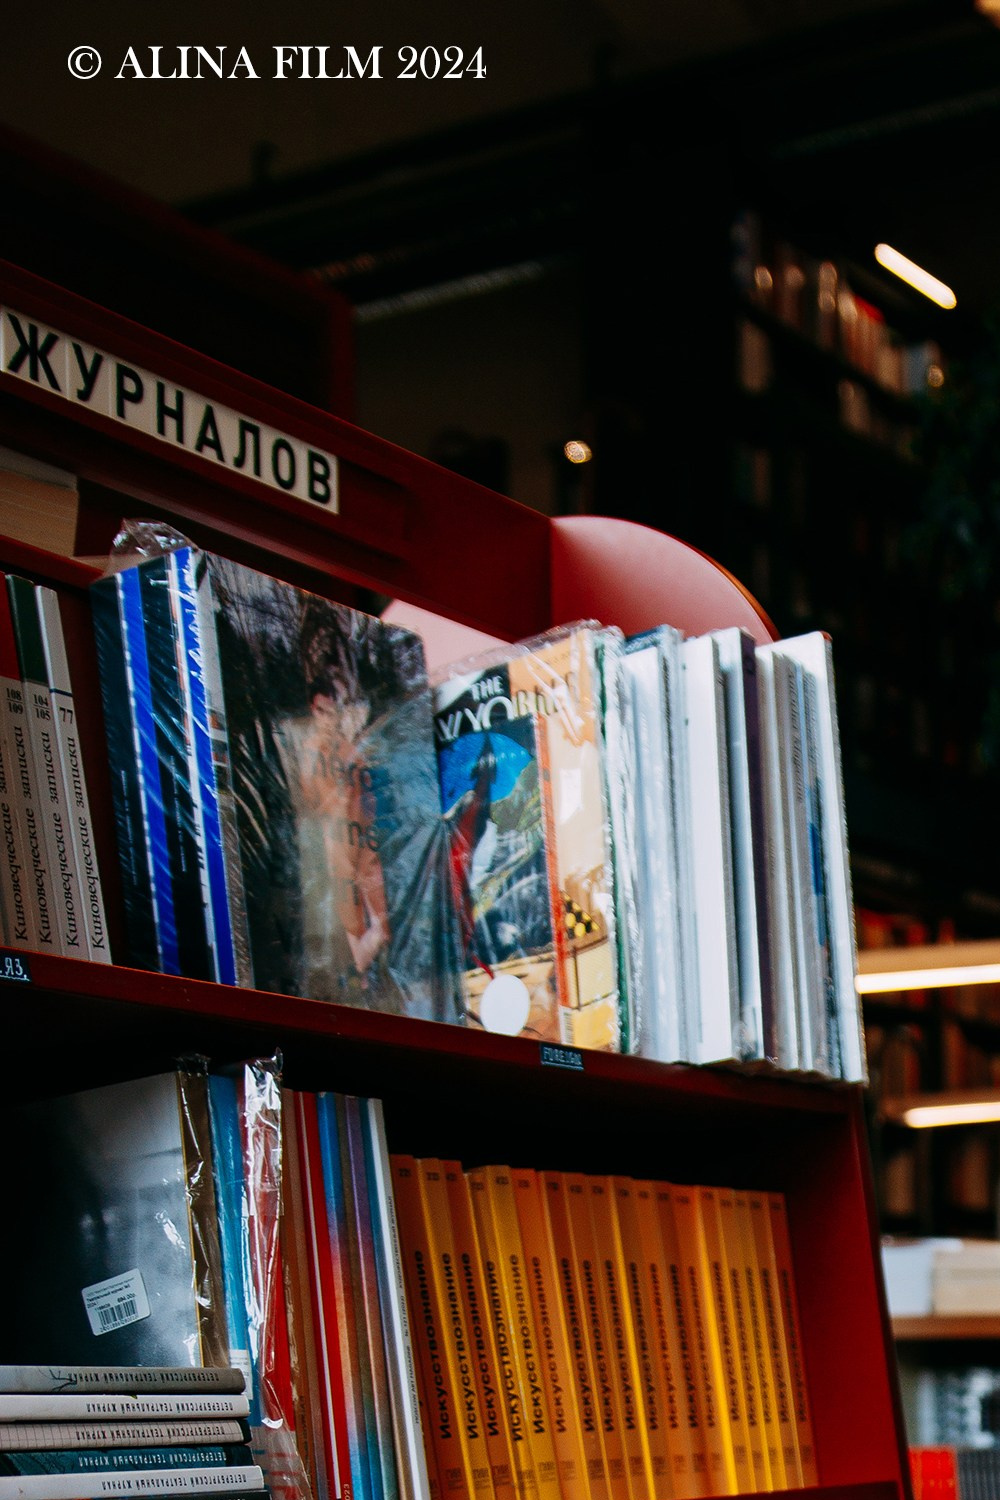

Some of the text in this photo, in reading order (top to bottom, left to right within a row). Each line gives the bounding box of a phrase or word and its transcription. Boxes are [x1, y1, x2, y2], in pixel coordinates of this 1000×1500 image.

[6, 311, 333, 505] ЖУРНАЛОВ
[471, 676, 504, 701] THE
[1, 803, 28, 941] Киноведческие
[14, 726, 52, 944] Киноведческие записки
[41, 731, 80, 947] Киноведческие записки
[60, 707, 105, 949] Киноведческие записки 77
[87, 1402, 234, 1414] ПЕТЕРБУРГСКИЙ ТЕАТРАЛЬНЫЙ ЖУРНАЛ
[104, 1373, 158, 1384] ТЕАТРАЛЬНЫЙ
[160, 1372, 219, 1384] ПЕТЕРБУРГСКИЙ
[415, 1251, 453, 1439] Искусствознание
[442, 1253, 478, 1439] Искусствознание
[461, 1252, 500, 1437] Искусствознание
[487, 1261, 525, 1441] Искусствознание
[510, 1254, 546, 1434] Искусствознание
[532, 1256, 567, 1433] Искусствознание
[561, 1258, 596, 1432] Искусствознание
[583, 1260, 615, 1432] Искусствознание
[604, 1259, 636, 1430] Искусствознание
[76, 1426, 225, 1441] ПЕТЕРБУРГСКИЙ ТЕАТРАЛЬНЫЙ ЖУРНАЛ
[78, 1452, 227, 1467] ПЕТЕРБУРГСКИЙ ТЕАТРАЛЬНЫЙ ЖУРНАЛ
[102, 1474, 247, 1491] ПЕТЕРБУРГСКИЙ ТЕАТРАЛЬНЫЙ ЖУРНАЛ
